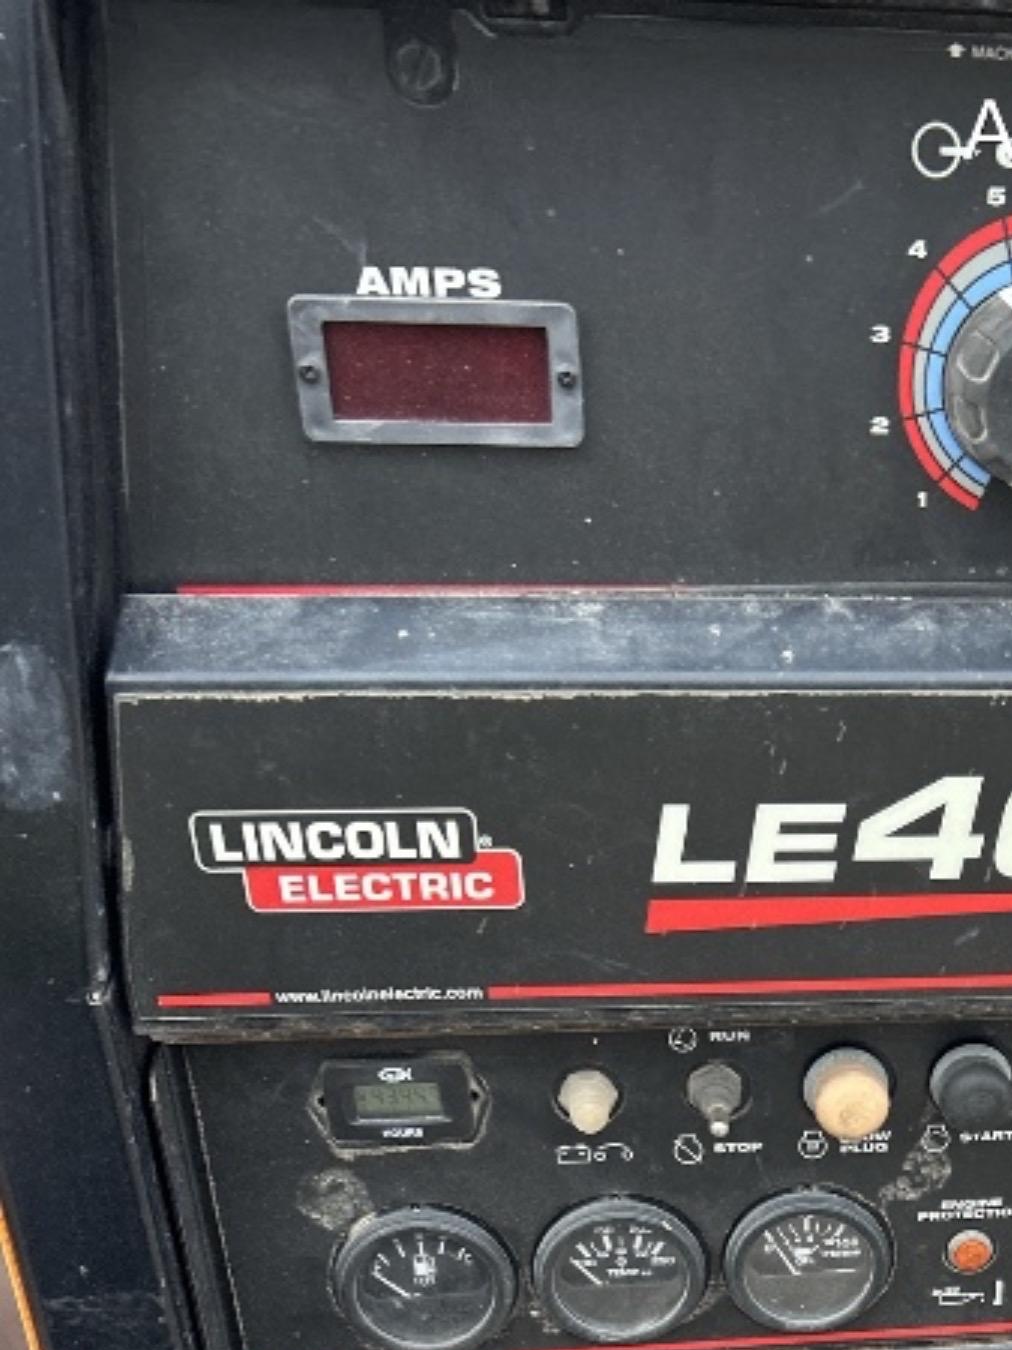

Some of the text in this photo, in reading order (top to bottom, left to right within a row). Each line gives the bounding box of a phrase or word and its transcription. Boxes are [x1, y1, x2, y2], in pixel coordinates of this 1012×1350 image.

[986, 186, 1007, 206] 5
[907, 239, 929, 259] 4
[354, 265, 503, 299] AMPS
[869, 324, 892, 345] 3
[869, 415, 891, 435] 2
[917, 491, 929, 509] 1
[208, 819, 463, 863] LINCOLN
[277, 871, 495, 904] ELECTRIC
[275, 986, 485, 1004] www.lincolnelectric.com
[709, 1030, 752, 1042] RUN
[712, 1141, 764, 1154] STOP
